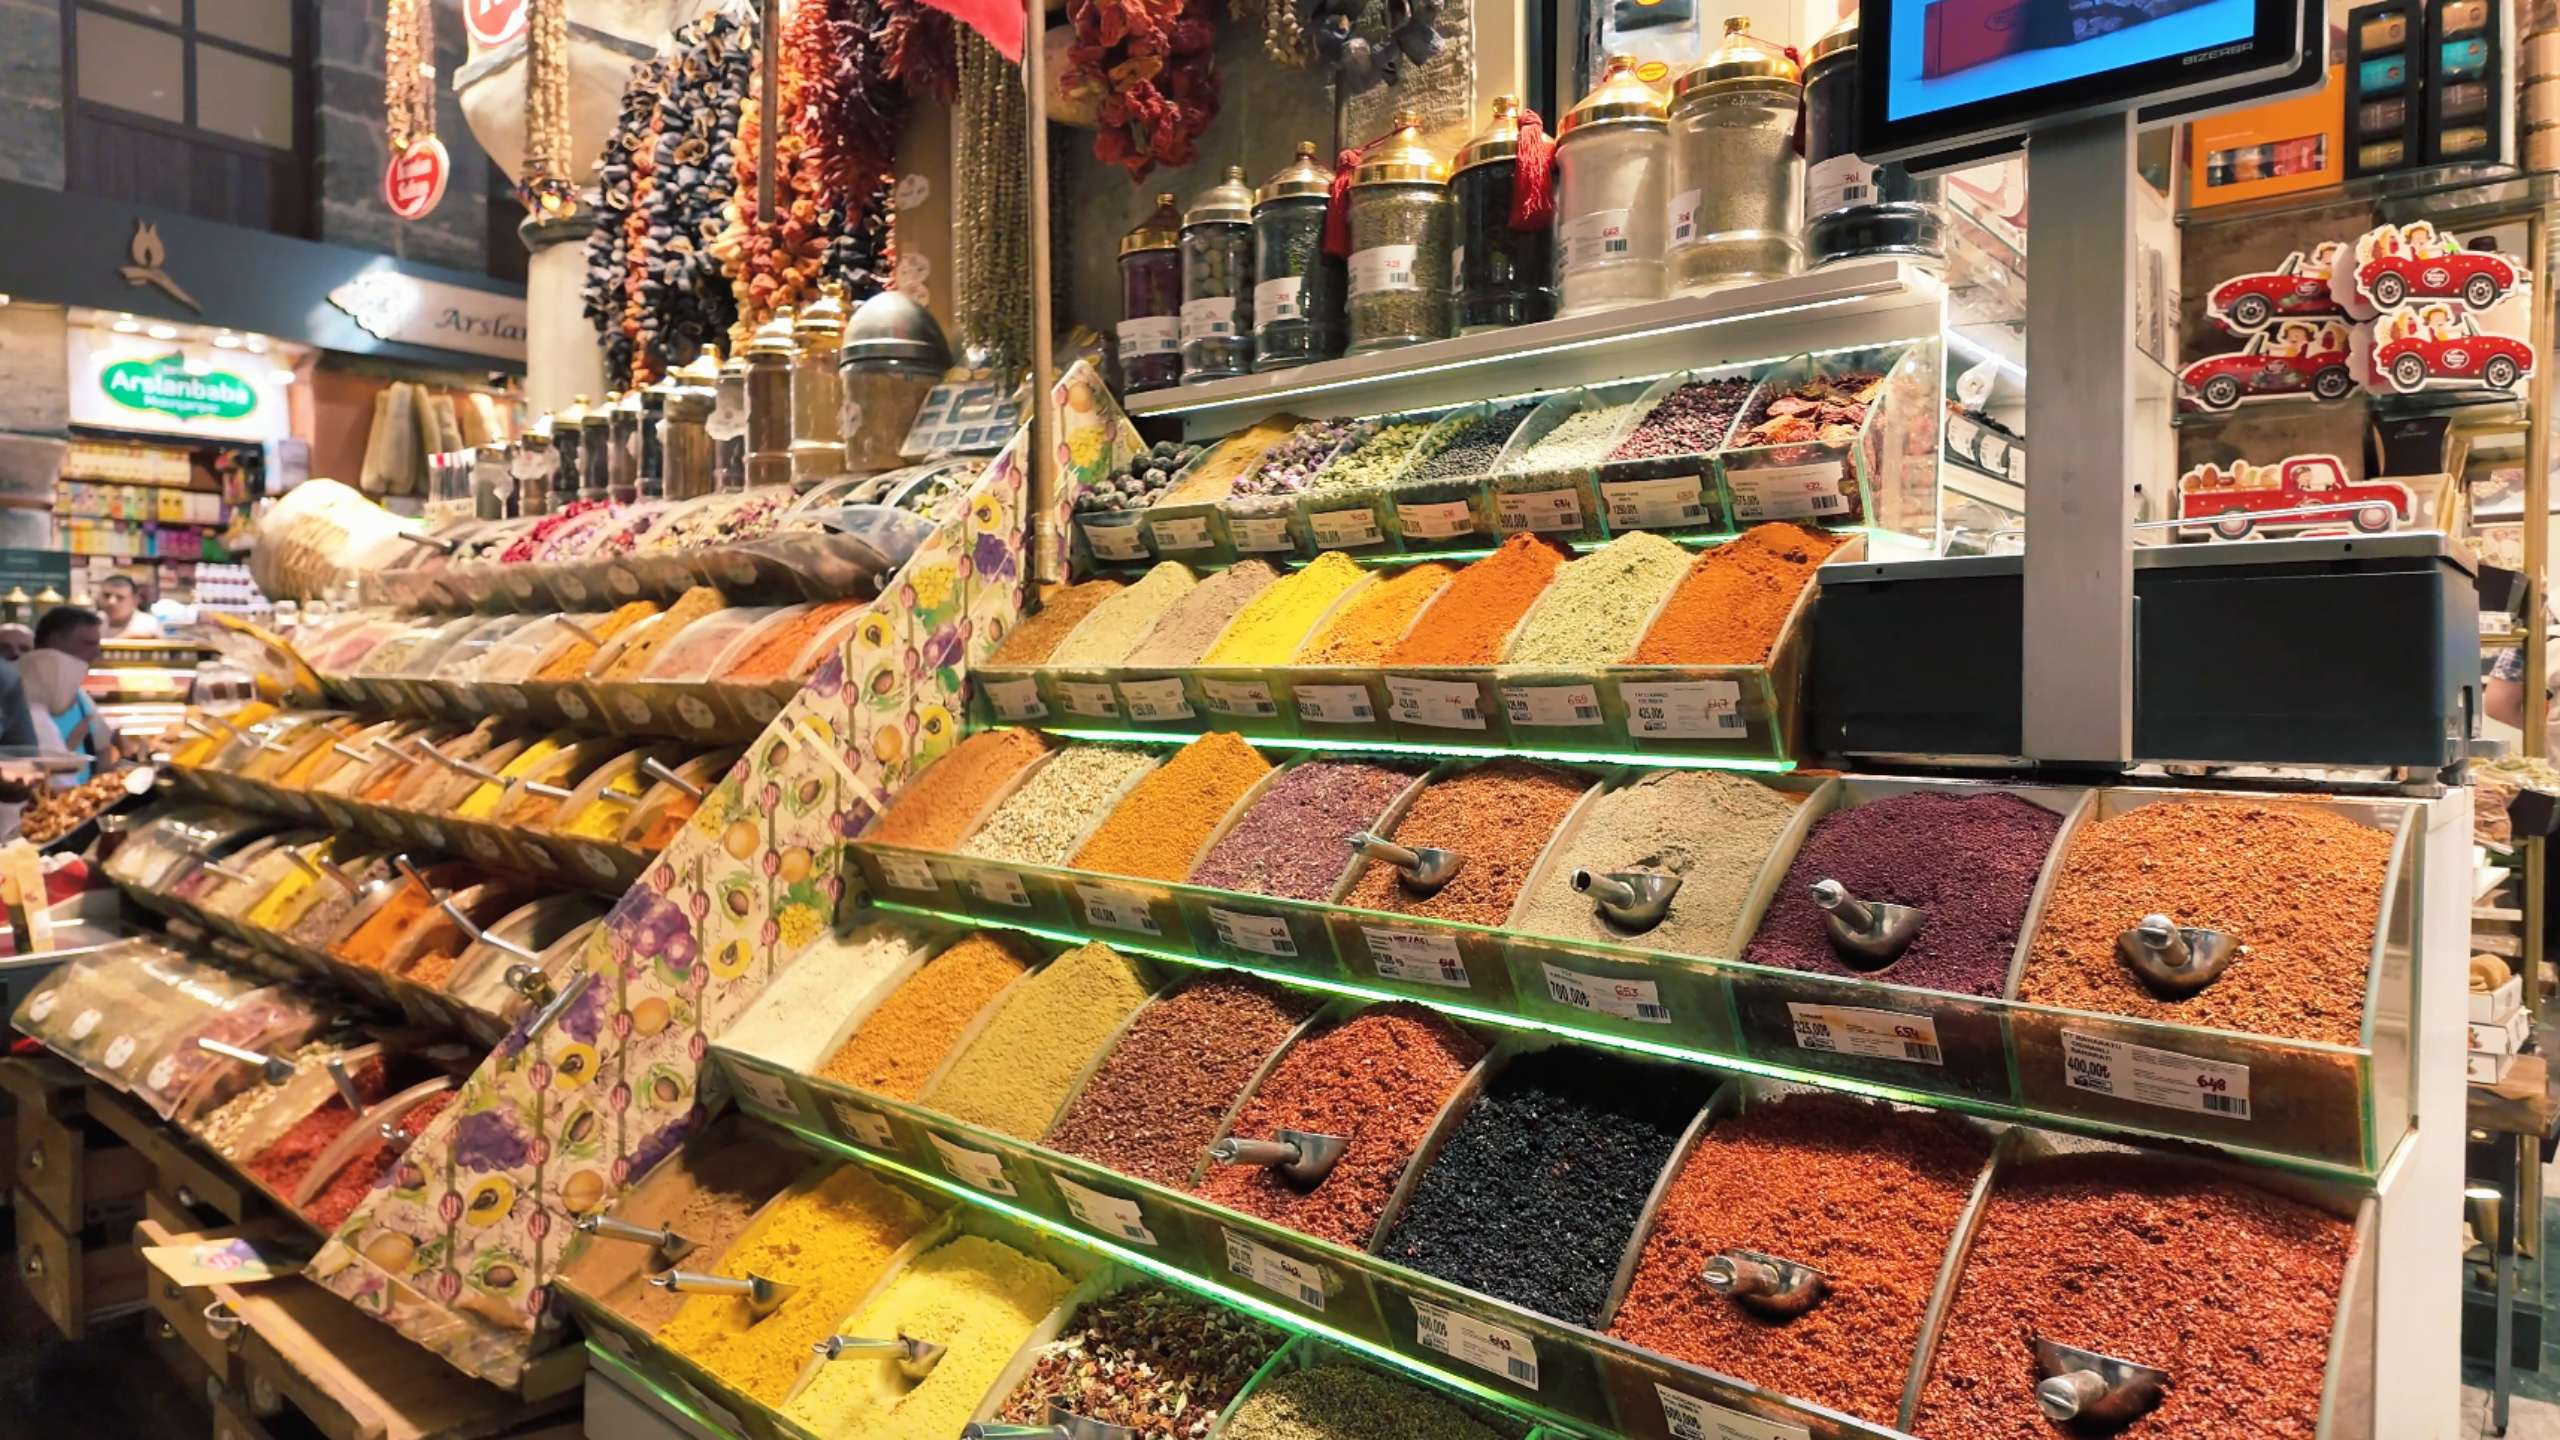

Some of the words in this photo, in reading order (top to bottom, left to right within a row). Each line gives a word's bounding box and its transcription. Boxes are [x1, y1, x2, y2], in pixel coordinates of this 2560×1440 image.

[2182, 42, 2254, 65] BIZERBA
[1614, 984, 1640, 998] 653
[2067, 1056, 2111, 1079] 400,00₺
[2197, 1074, 2227, 1092] 648
